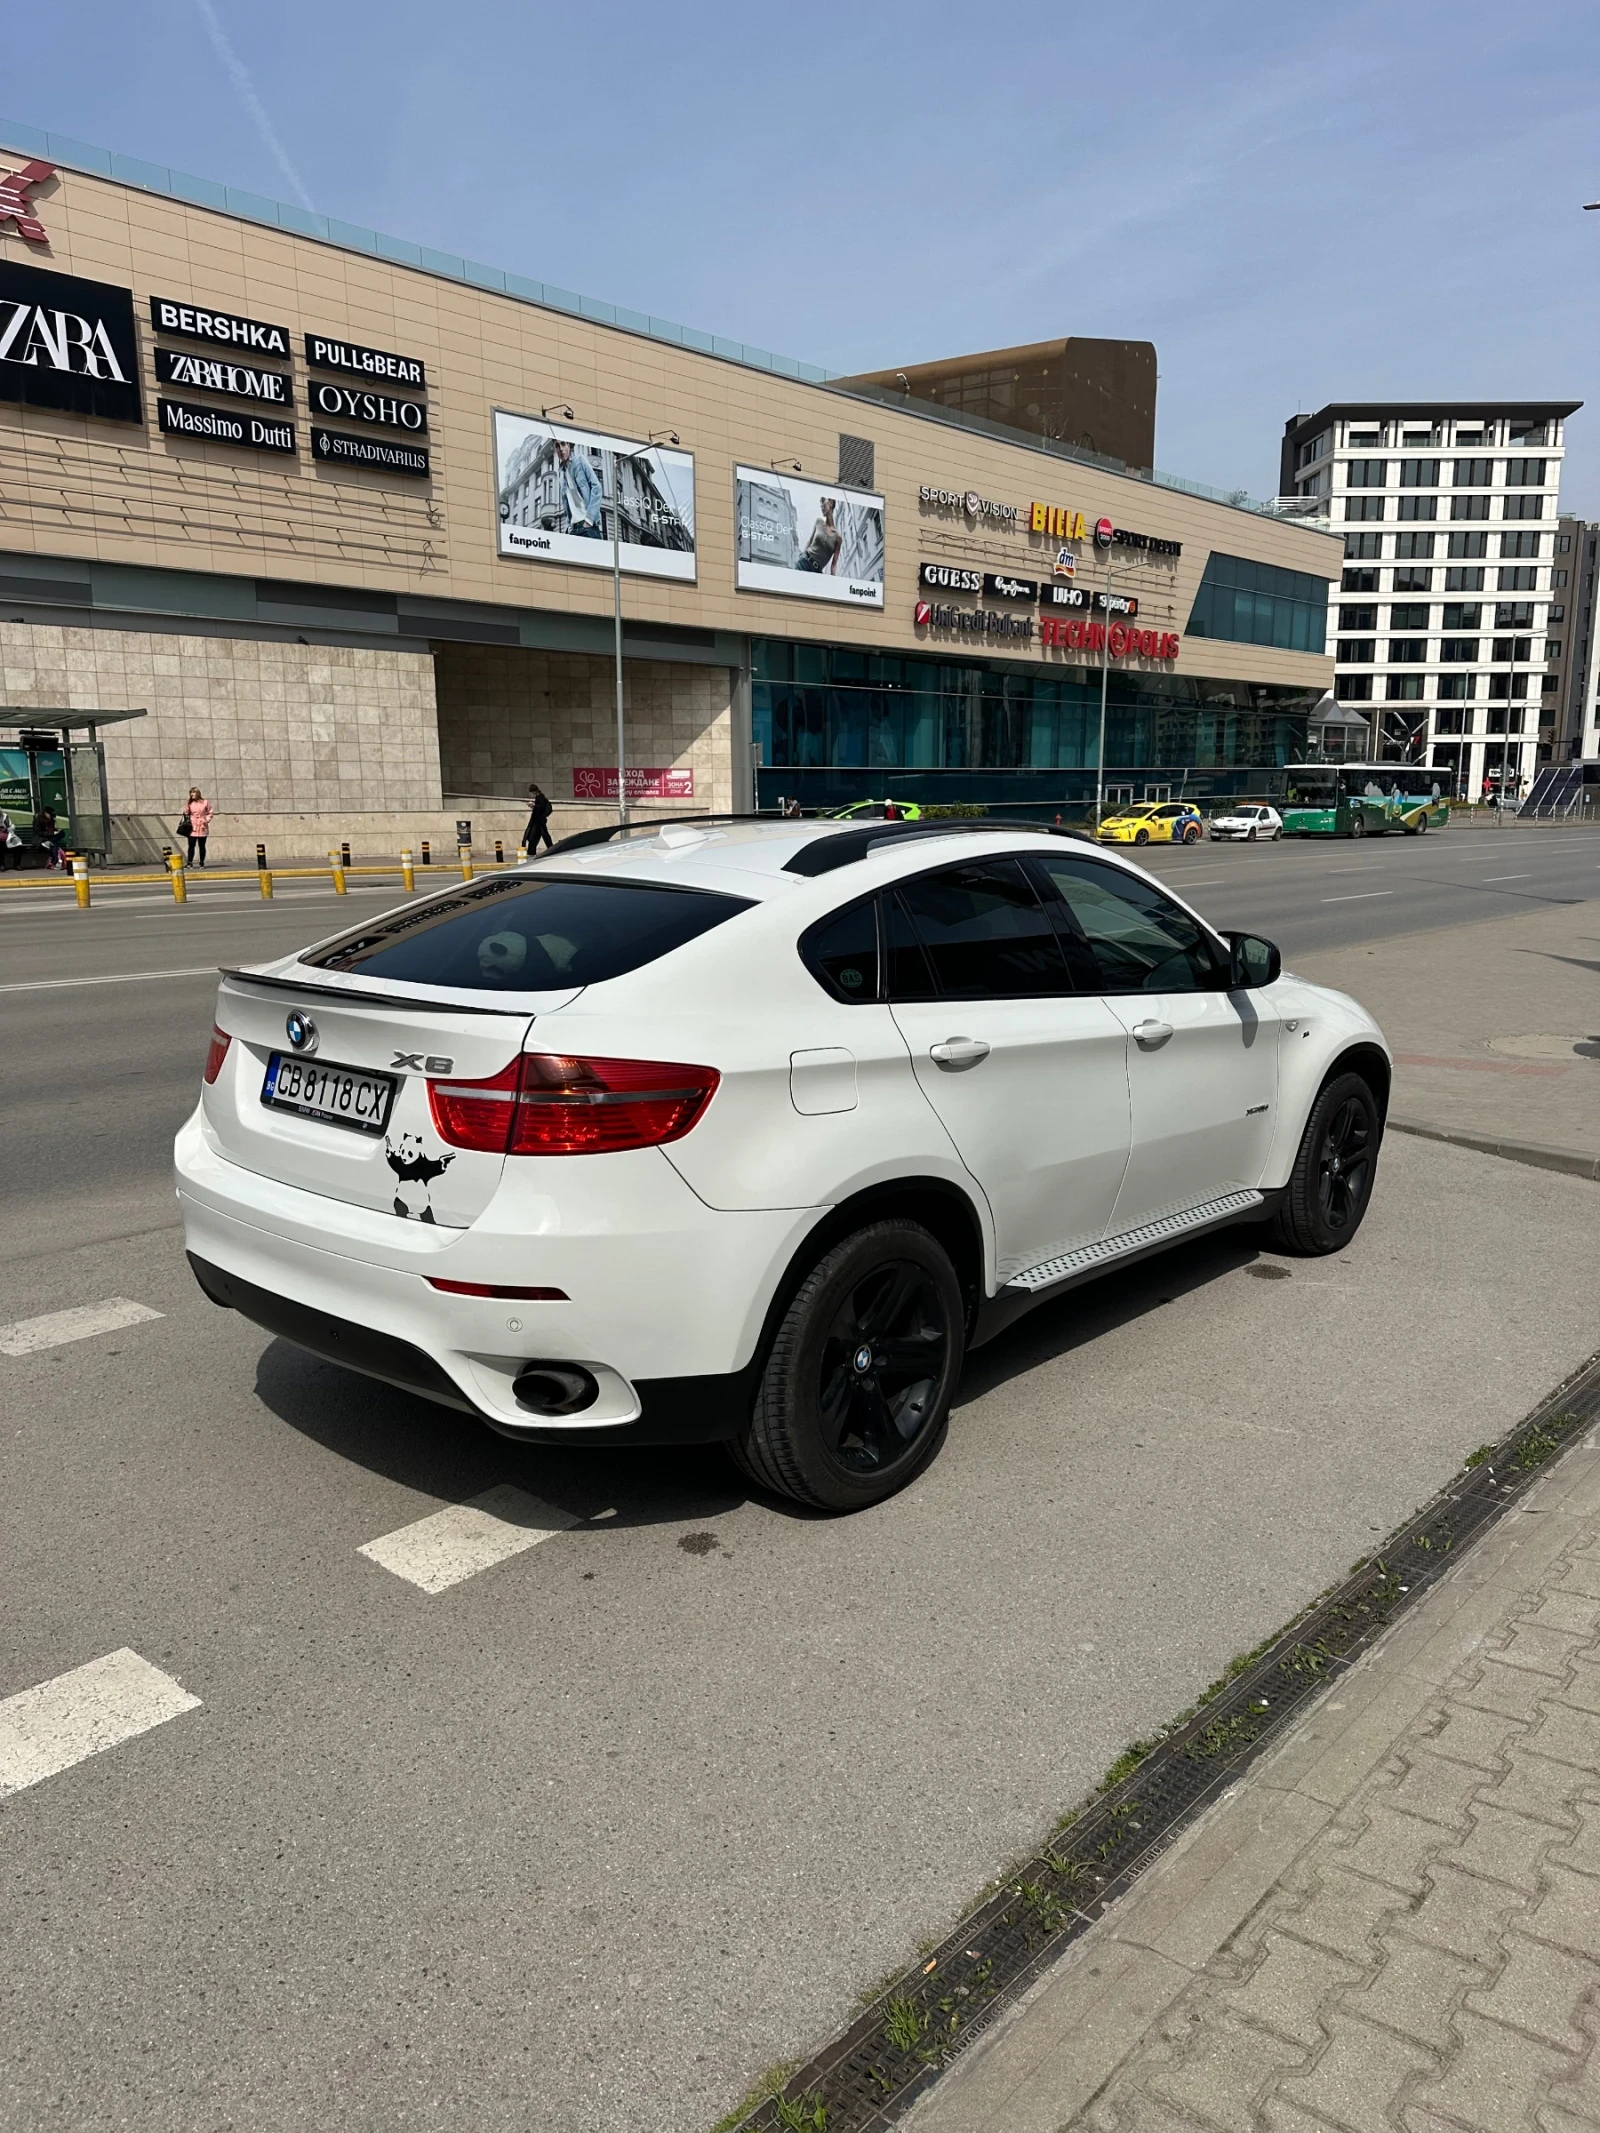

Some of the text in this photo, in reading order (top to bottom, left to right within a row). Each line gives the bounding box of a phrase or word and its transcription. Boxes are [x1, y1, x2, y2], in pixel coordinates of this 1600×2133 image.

[0, 300, 132, 384] ZARA
[160, 304, 286, 353] BERSHKA
[314, 341, 422, 383] PULL&BEAR
[319, 386, 422, 429] OYSHO
[167, 405, 292, 449] Massimo Dutti
[333, 439, 426, 470] STRADIVARIUS
[920, 486, 1019, 520] SPORT VISION
[1030, 502, 1087, 541] BILLA
[509, 533, 551, 550] fanpoint
[1113, 528, 1183, 556] SPORT DEPOT
[1059, 548, 1074, 568] dm
[850, 585, 877, 598] fanpoint
[924, 565, 980, 590] GUESS
[1099, 594, 1130, 613] Sperdry
[931, 603, 1035, 637] UniCredit Bulbank
[1040, 616, 1180, 659] TECHNOPOLIS
[607, 778, 659, 787] ЗАЕЖДАНЕ
[625, 770, 644, 778] ХОД
[684, 781, 692, 794] 2
[266, 1080, 275, 1091] BG
